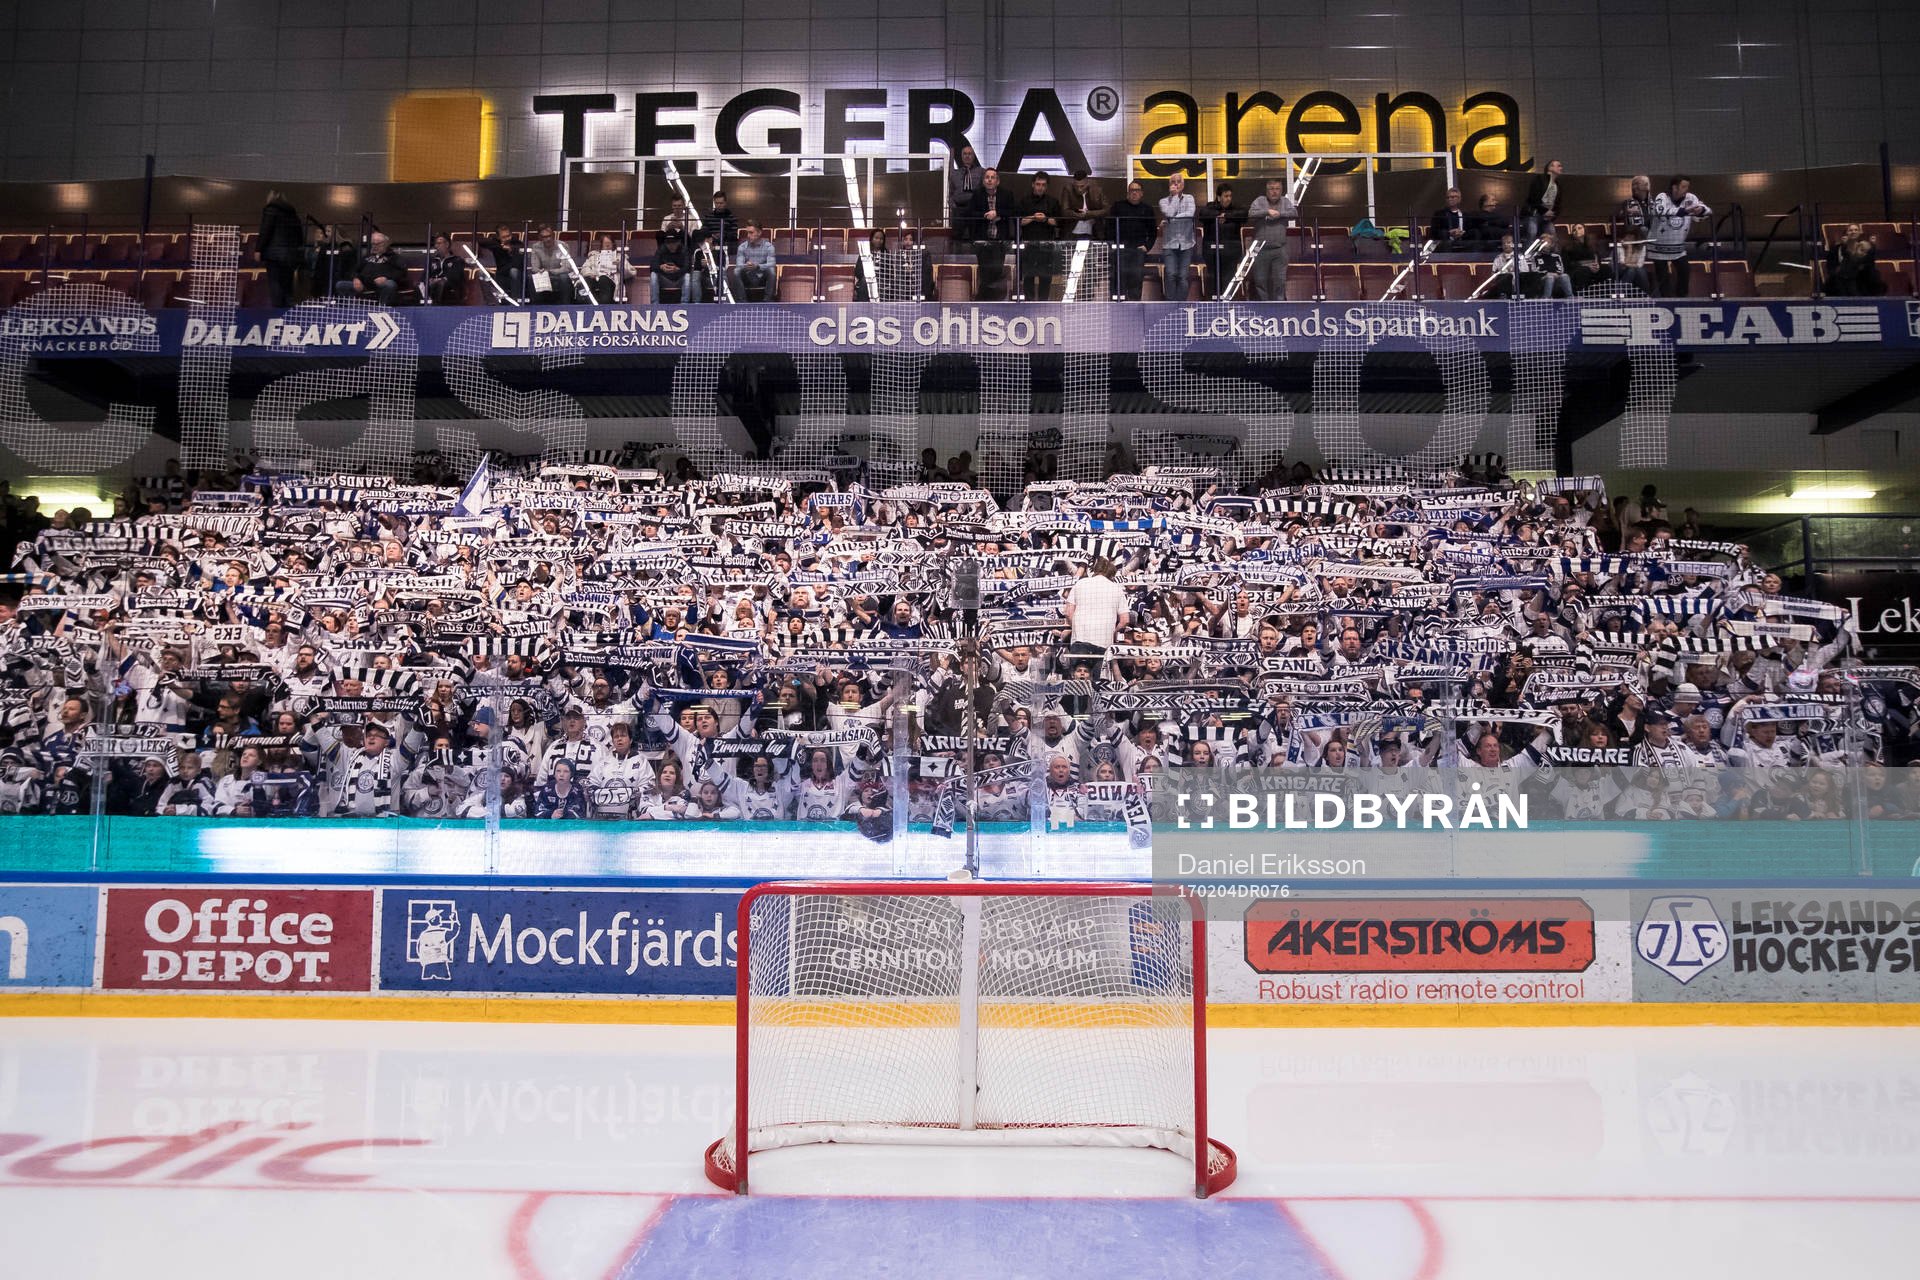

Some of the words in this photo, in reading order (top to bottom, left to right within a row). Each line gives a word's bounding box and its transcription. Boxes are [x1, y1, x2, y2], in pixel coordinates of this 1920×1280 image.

[533, 88, 1091, 175] TEGERA
[1139, 90, 1534, 177] arena
[2, 317, 157, 335] LEKSANDS
[536, 310, 689, 332] DALARNAS
[809, 307, 901, 345] clas
[912, 307, 1062, 345] ohlson
[1184, 307, 1338, 337] Leksands
[1345, 307, 1499, 344] Sparbank
[1625, 306, 1842, 345] PEAB
[534, 336, 574, 347] BANK
[577, 336, 589, 347] &
[592, 332, 688, 347] FÖRSÄKRING
[818, 494, 851, 505] STARS
[324, 699, 368, 710] Dalarnas
[373, 698, 419, 711] Stolthet
[765, 739, 786, 754] lag
[921, 736, 1010, 752] KRIGARE
[1547, 747, 1630, 764] KRIGARE
[1260, 775, 1347, 793] KRIGARE
[145, 899, 333, 945] Office
[1732, 900, 1920, 936] LEKSANDS
[1267, 908, 1568, 956] ÅKERSTRÖMS
[469, 911, 738, 975] Mockfjärds
[992, 949, 1097, 970] NOVUM
[1260, 979, 1344, 1000] Robust
[1350, 979, 1411, 1000] radio
[1416, 982, 1497, 1000] remote
[1502, 979, 1585, 1000] control
[0, 1120, 432, 1184] dic
